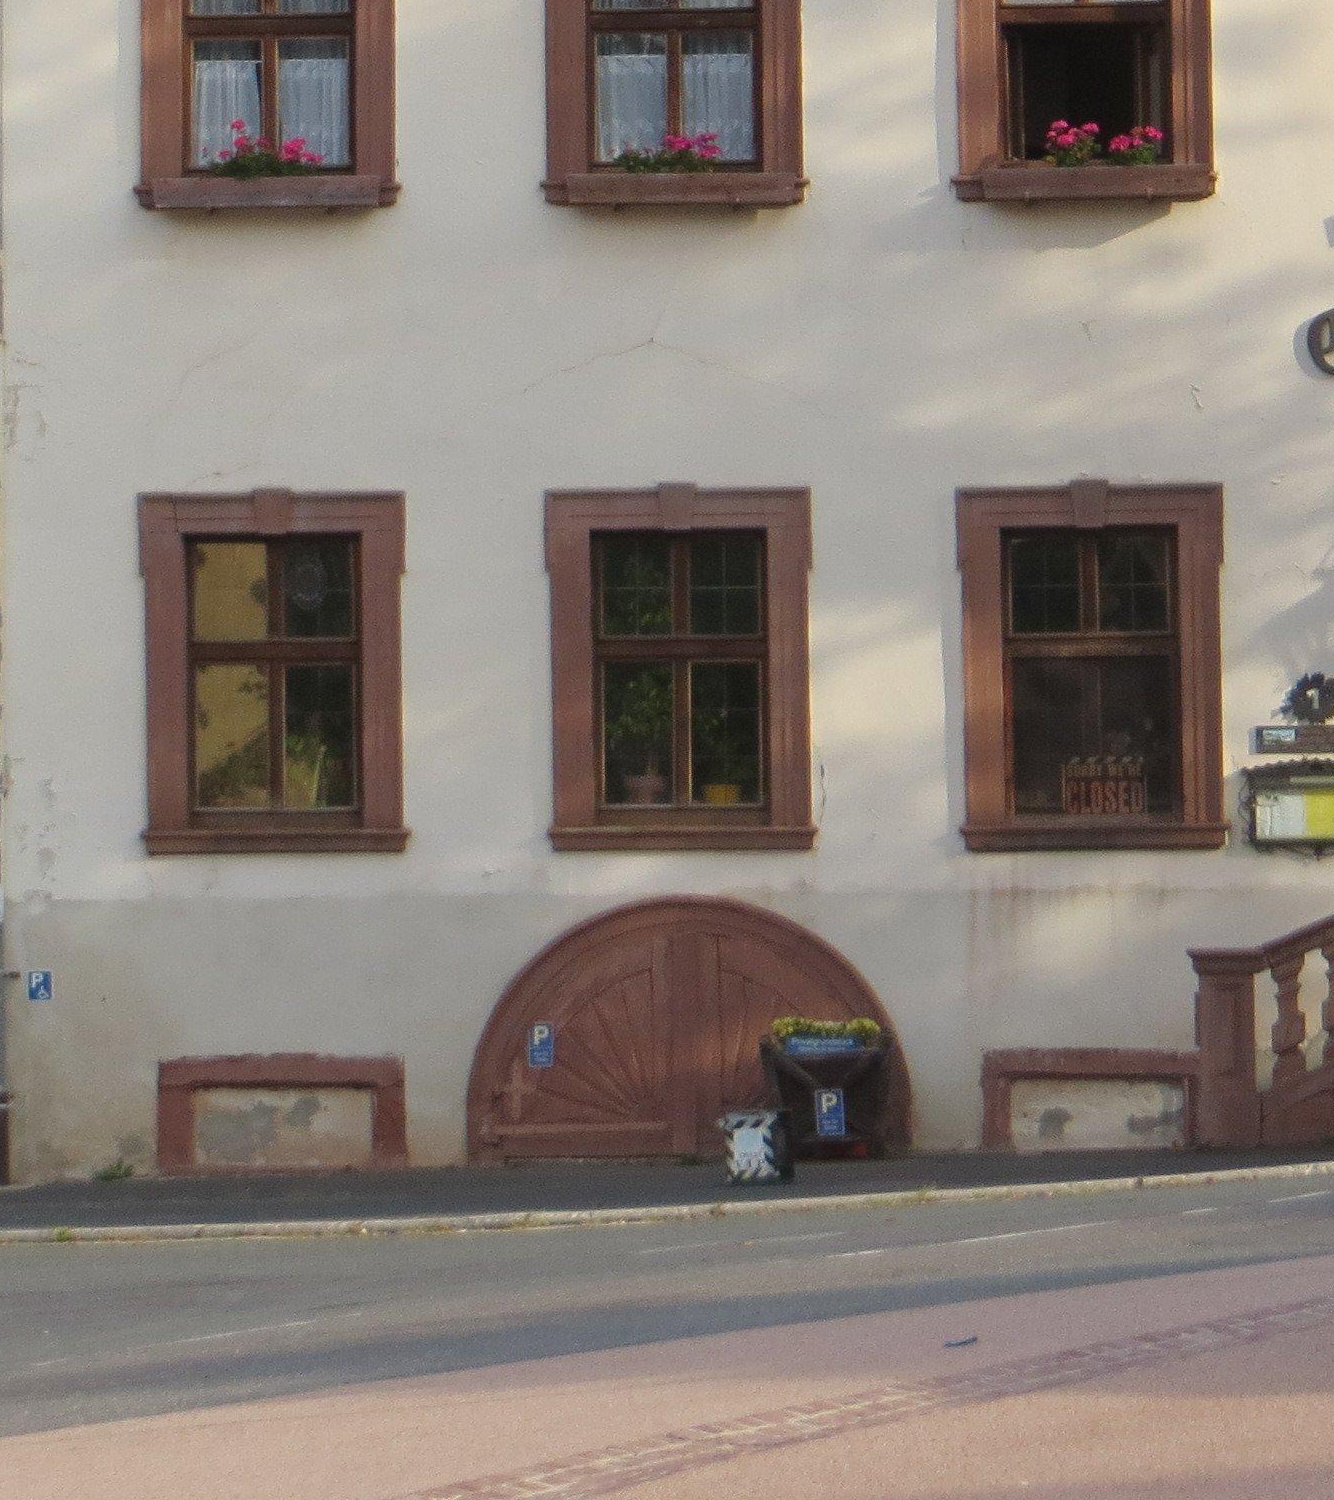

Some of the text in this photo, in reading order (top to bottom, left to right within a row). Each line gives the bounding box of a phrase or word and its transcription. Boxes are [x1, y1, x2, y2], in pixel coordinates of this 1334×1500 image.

[1305, 687, 1320, 710] 1
[1065, 780, 1144, 814] CLOSED
[31, 972, 44, 988] P
[534, 1025, 549, 1045] P
[821, 1092, 837, 1113] P
